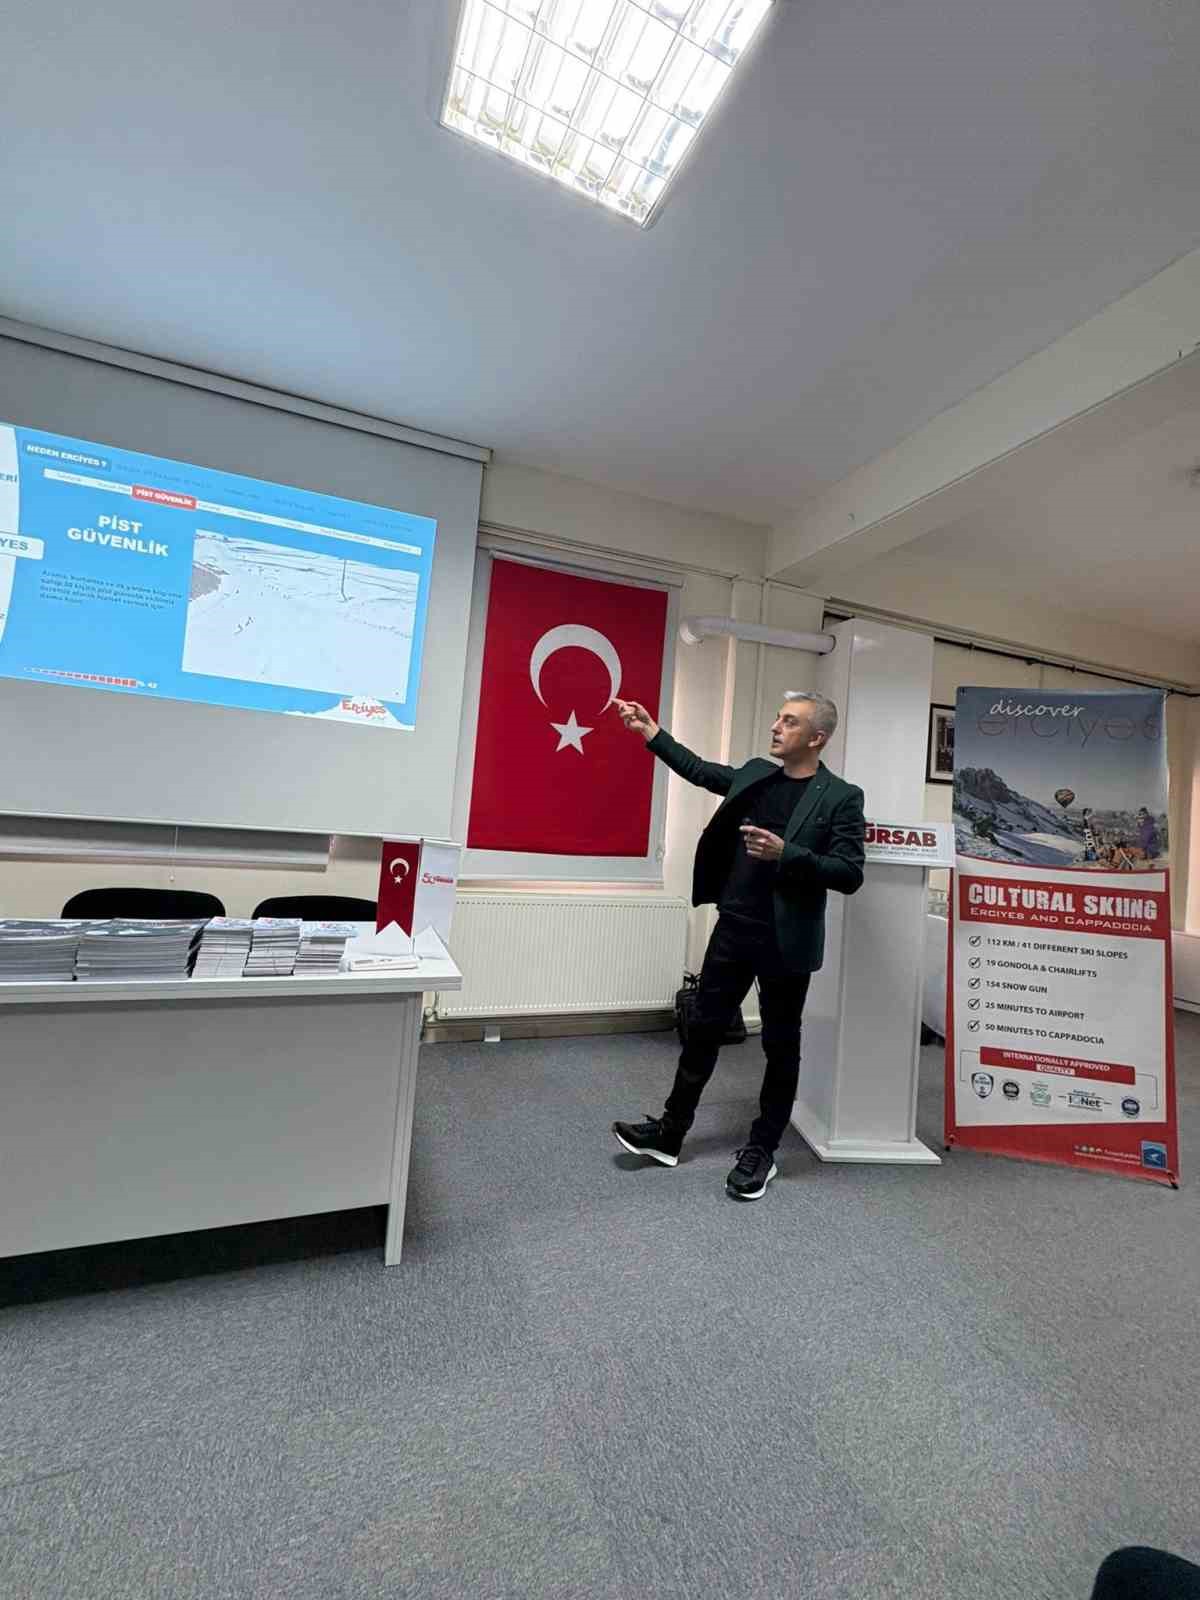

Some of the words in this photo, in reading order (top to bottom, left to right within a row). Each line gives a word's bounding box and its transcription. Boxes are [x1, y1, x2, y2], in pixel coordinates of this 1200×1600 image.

[97, 514, 144, 535] PİST
[67, 527, 170, 558] GÜVENLİK
[990, 698, 1086, 718] discover
[864, 822, 937, 848] ÜRSAB
[968, 883, 1076, 913] CULTURAL
[1083, 895, 1158, 921] SKIING
[986, 937, 1001, 946] 112
[1002, 939, 1017, 948] KM
[1022, 941, 1032, 950] 41
[1033, 942, 1080, 955] DIFFERENT
[1080, 947, 1096, 956] SKI
[1096, 949, 1129, 960] SLOPES
[986, 958, 996, 967] 19
[998, 960, 1039, 972] GONDOLA
[1048, 966, 1098, 978] CHAIRLIFTS
[1001, 981, 1028, 991] SNOW
[1028, 984, 1048, 994] GUN
[985, 1001, 996, 1010] 25
[997, 1003, 1034, 1015] MINUTES
[1035, 1008, 1047, 1016] TO
[1048, 1009, 1085, 1020] AIRPORT
[985, 1023, 996, 1031] 50
[996, 1024, 1034, 1036] MINUTES
[1035, 1029, 1047, 1038] TO
[1048, 1031, 1105, 1045] CAPPADOCIA
[1003, 1051, 1069, 1067] INTERNATIONALLY
